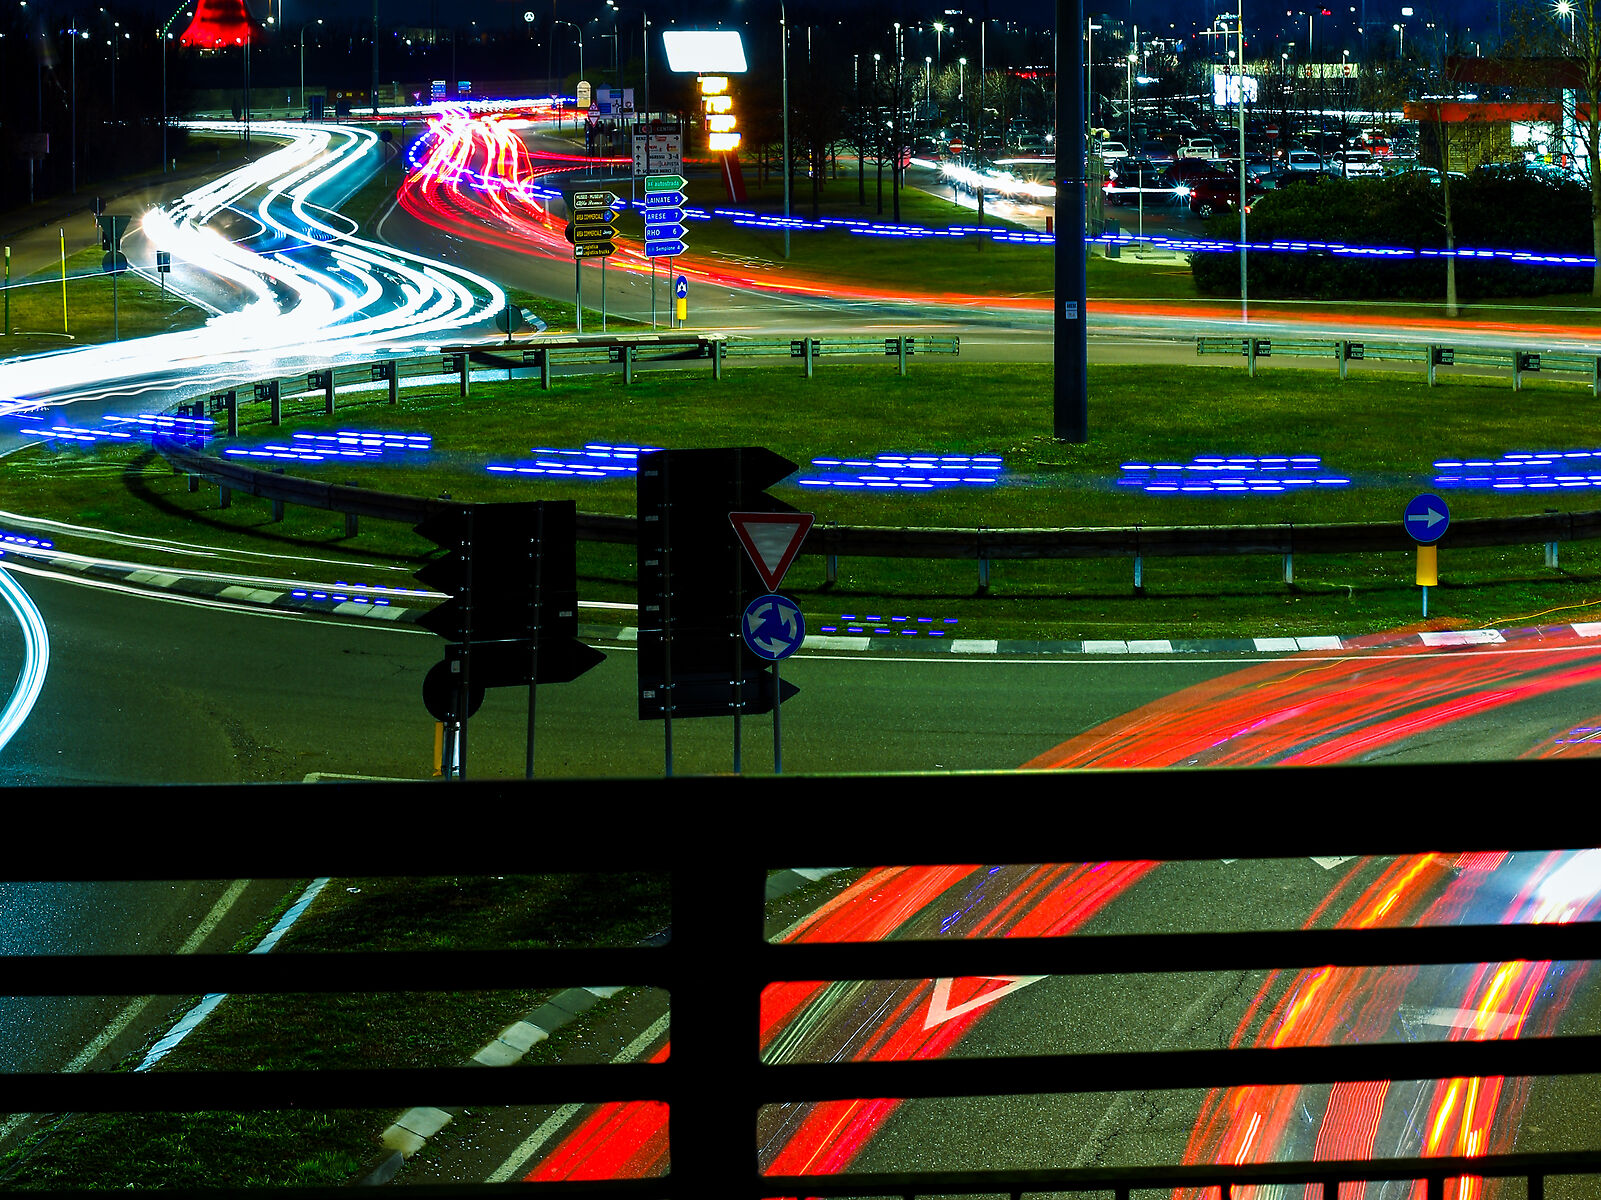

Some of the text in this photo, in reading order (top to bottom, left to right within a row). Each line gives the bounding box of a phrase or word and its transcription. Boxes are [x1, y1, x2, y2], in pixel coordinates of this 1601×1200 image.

[647, 196, 671, 204] LAINATE
[647, 212, 666, 220] ARESE
[647, 229, 661, 237] RHO
